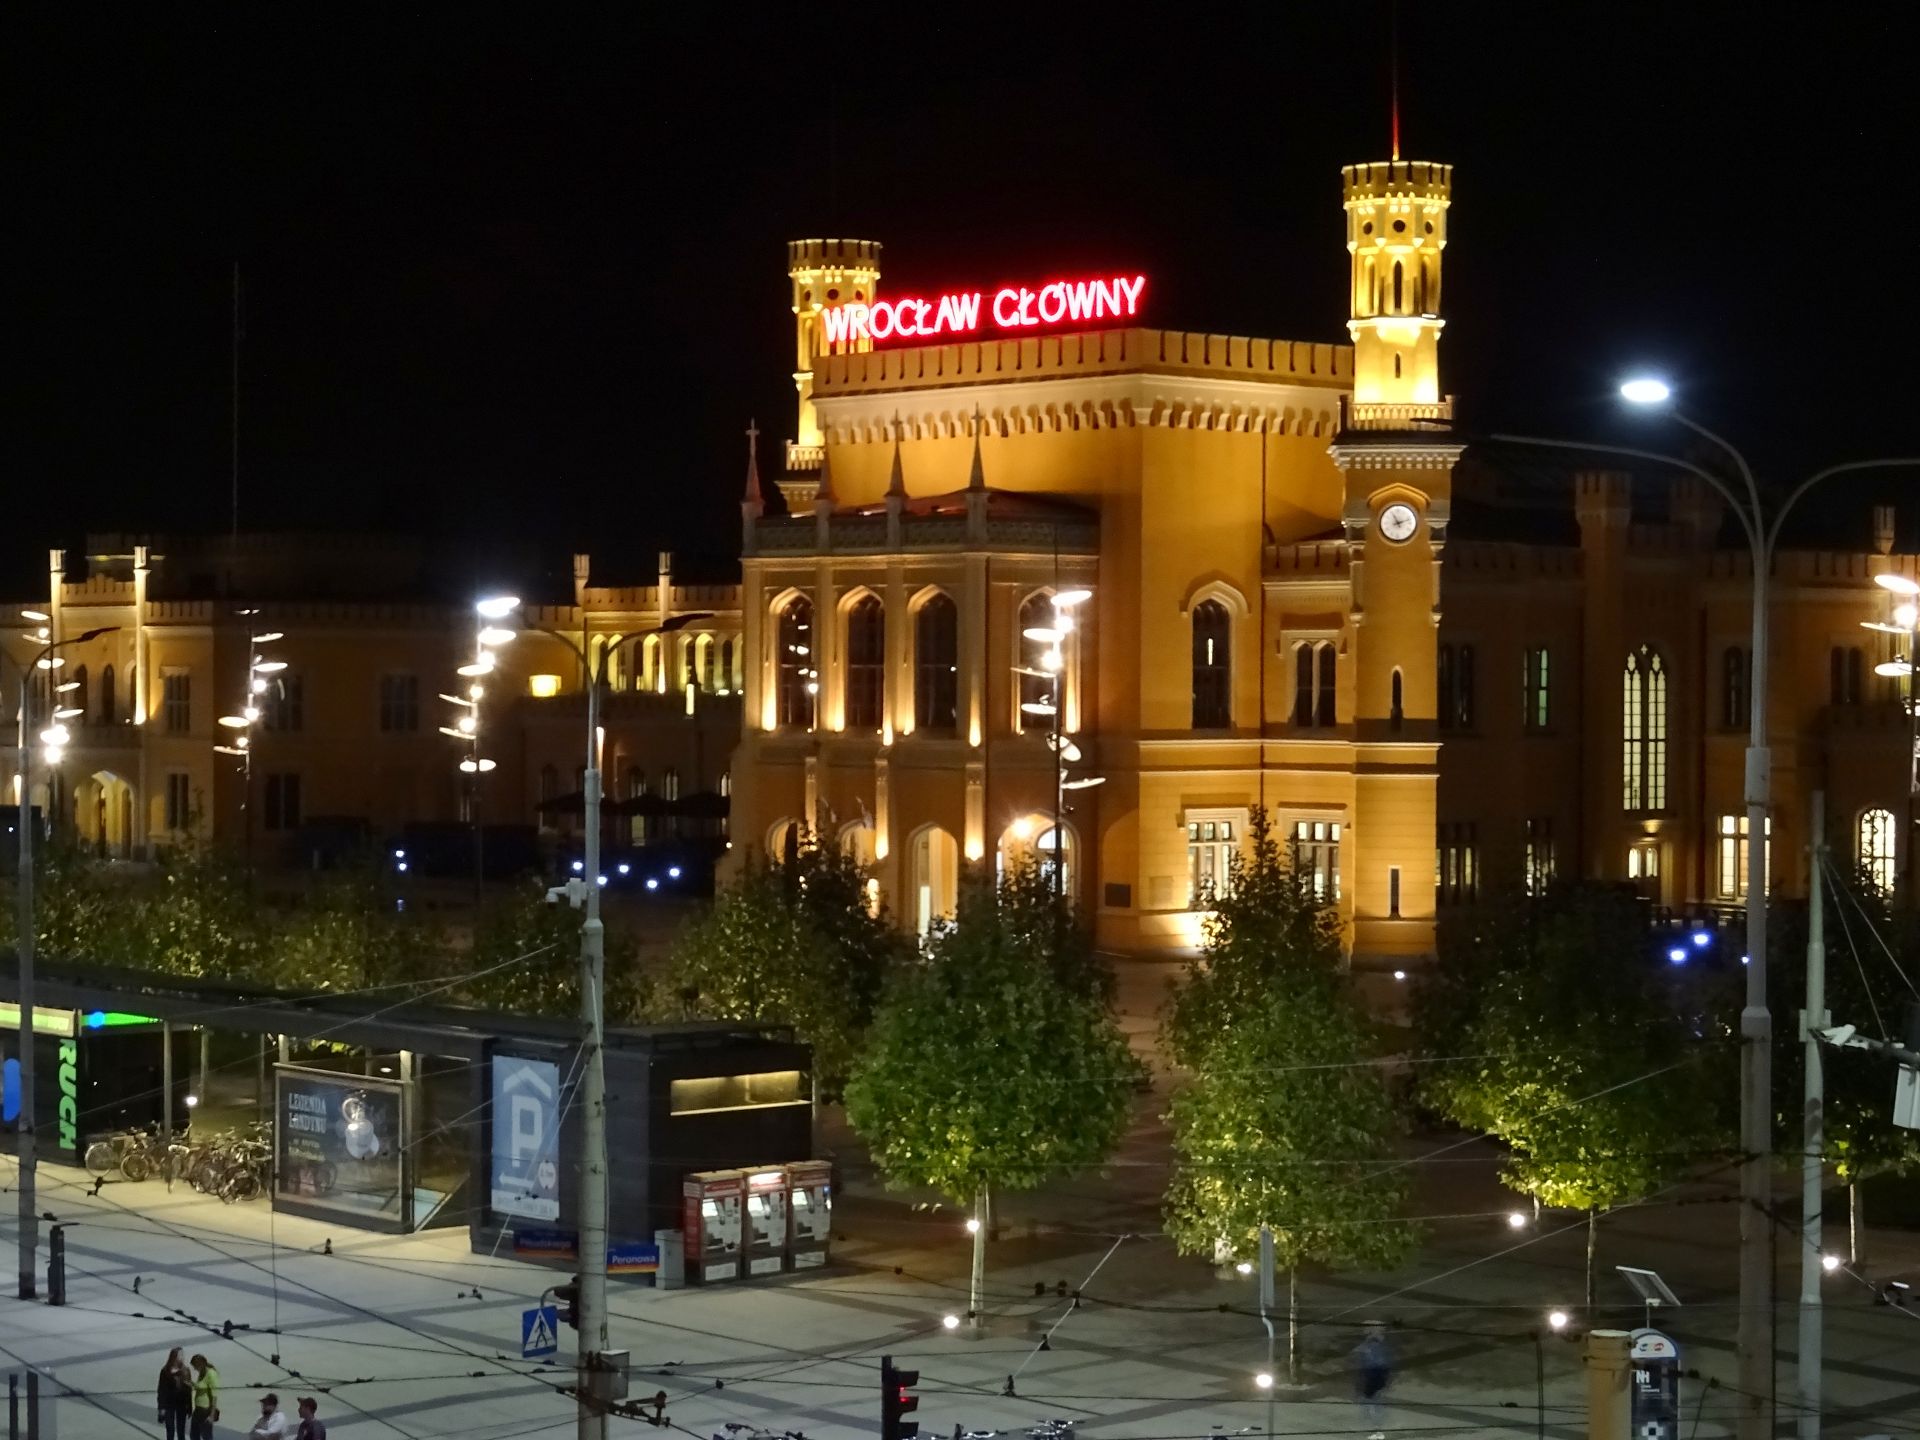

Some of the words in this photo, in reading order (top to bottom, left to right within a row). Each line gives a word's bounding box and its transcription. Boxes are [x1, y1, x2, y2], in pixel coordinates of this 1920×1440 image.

[823, 293, 981, 342] WROCŁAW
[993, 276, 1145, 327] GŁÓWNY
[59, 1038, 77, 1150] RUCH
[512, 1096, 542, 1167] P
[612, 1255, 656, 1264] Peronowa
